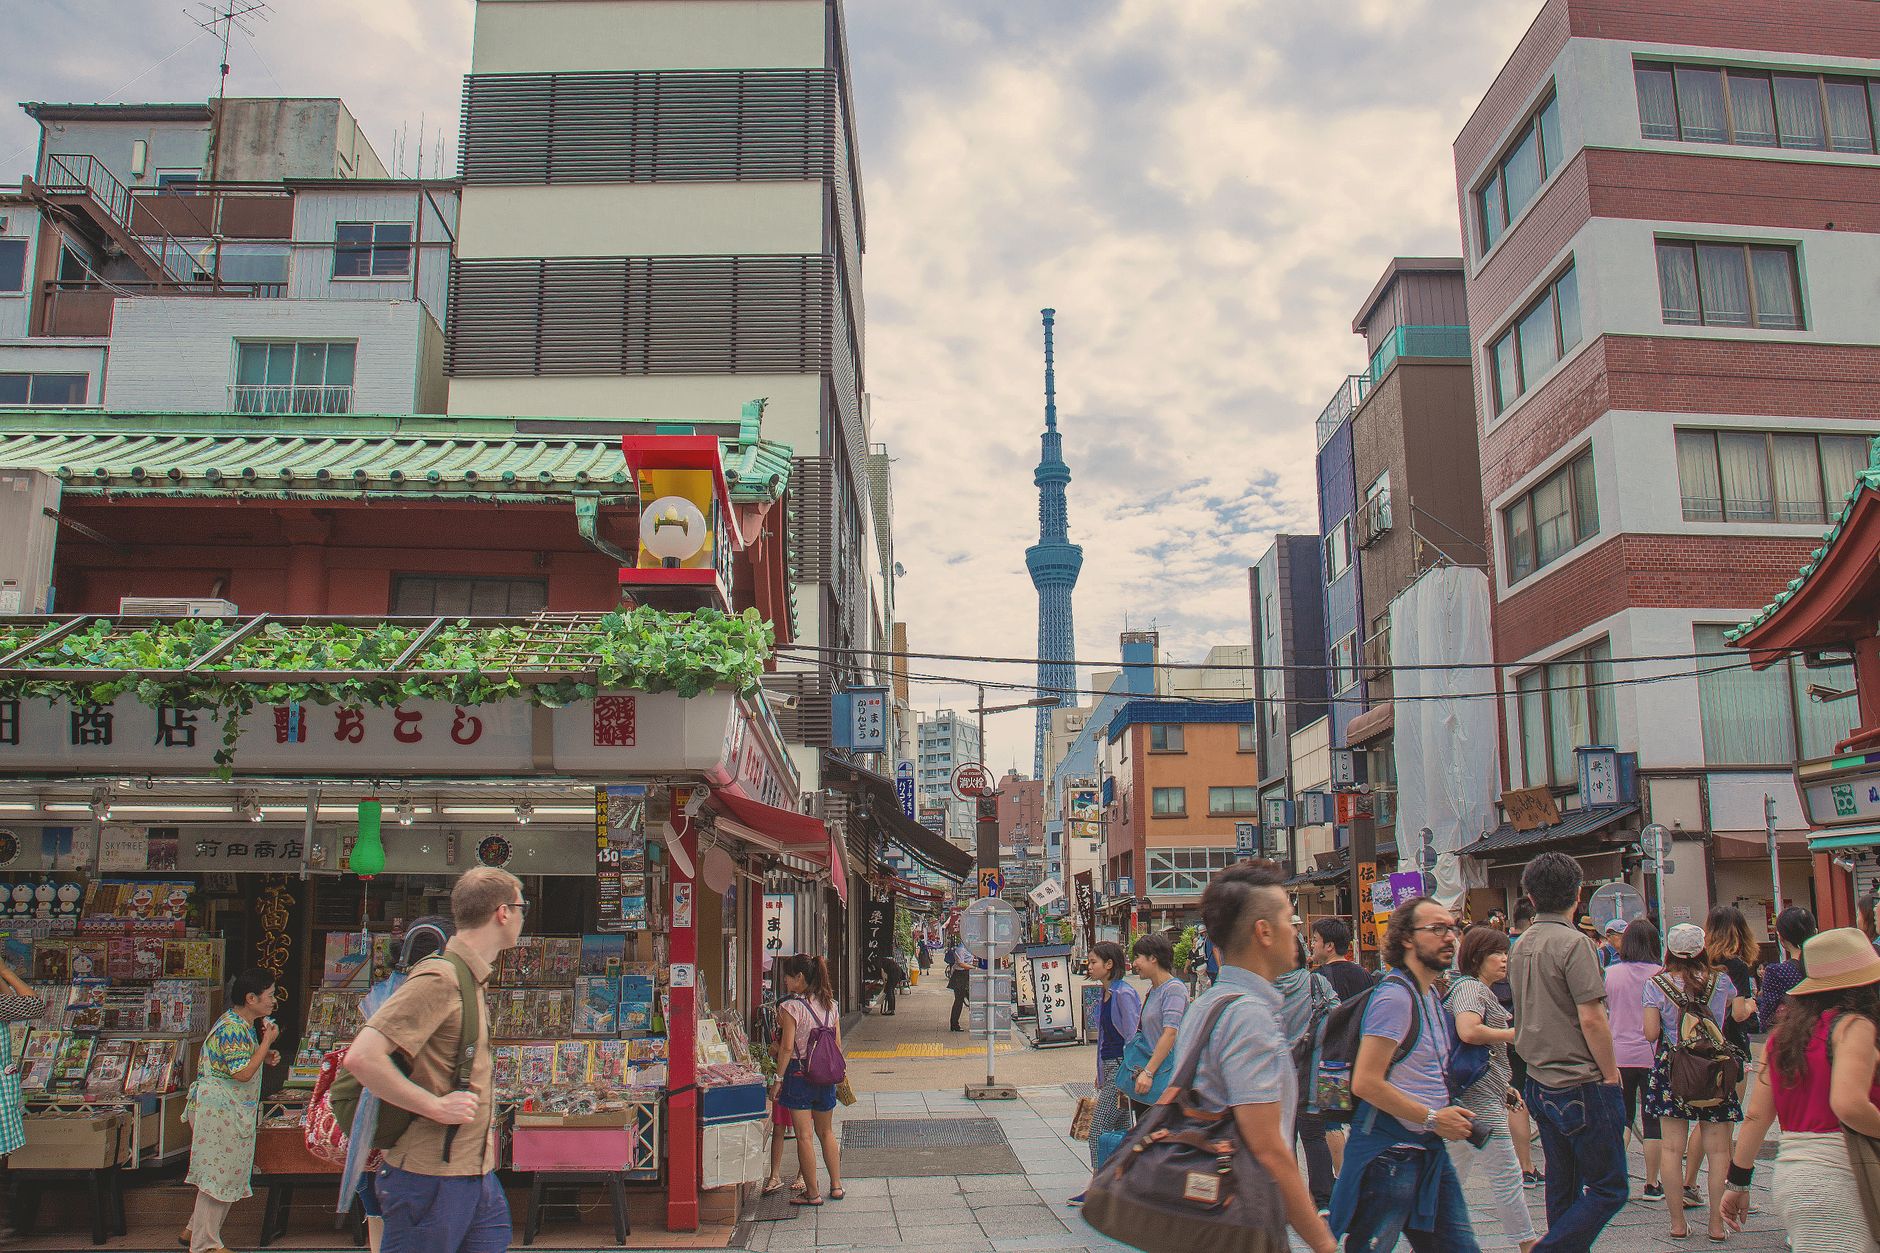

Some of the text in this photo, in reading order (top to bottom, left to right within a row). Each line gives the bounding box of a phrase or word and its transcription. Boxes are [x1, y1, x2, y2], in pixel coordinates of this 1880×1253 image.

[857, 699, 867, 740] かりんとう
[869, 712, 880, 738] まめ
[959, 776, 985, 789] 消火栓
[105, 841, 143, 850] SKYTREE
[195, 839, 304, 860] 前田商店
[597, 848, 619, 863] 130
[766, 916, 783, 950] まめ
[1040, 972, 1053, 1025] かりんとう
[1054, 983, 1066, 1008] まめ
